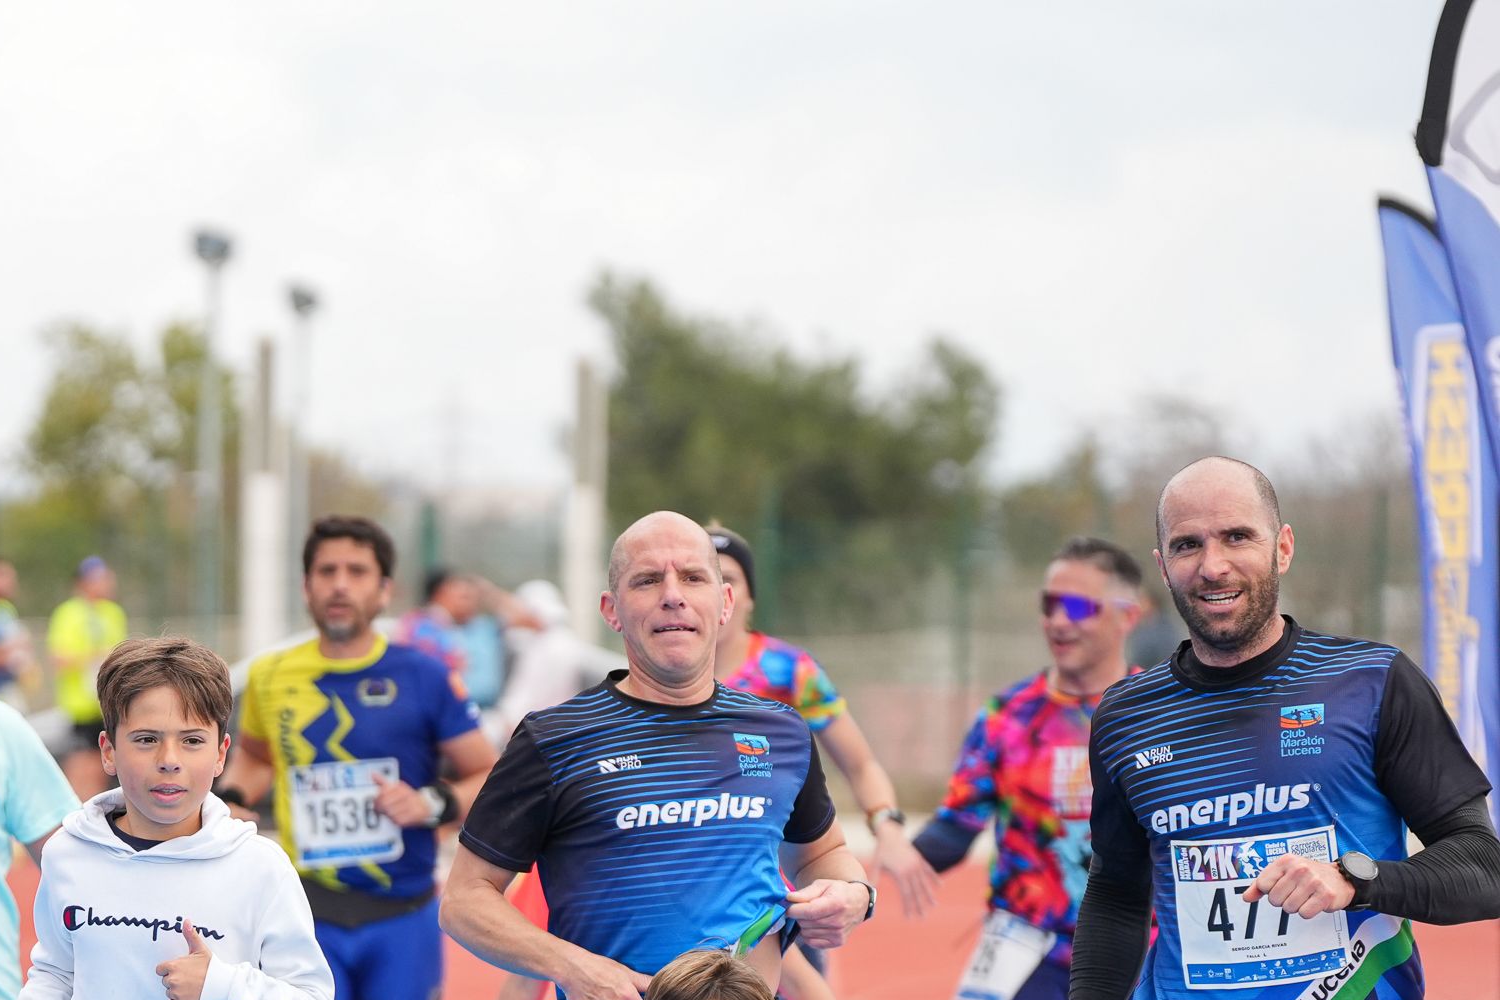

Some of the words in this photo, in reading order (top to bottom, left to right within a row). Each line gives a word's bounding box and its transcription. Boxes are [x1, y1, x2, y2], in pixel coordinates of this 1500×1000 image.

[1280, 729, 1306, 740] Club
[1280, 735, 1325, 748] Maratón
[1150, 744, 1171, 758] RUN
[1280, 746, 1322, 758] Lucena
[615, 754, 638, 763] RUN
[620, 759, 642, 770] PRO
[738, 754, 759, 764] Club
[1152, 752, 1174, 765] PRO
[741, 768, 772, 778] Lucena
[616, 792, 766, 830] enerplus
[1151, 783, 1311, 834] enerplus
[1189, 845, 1238, 881] 21K
